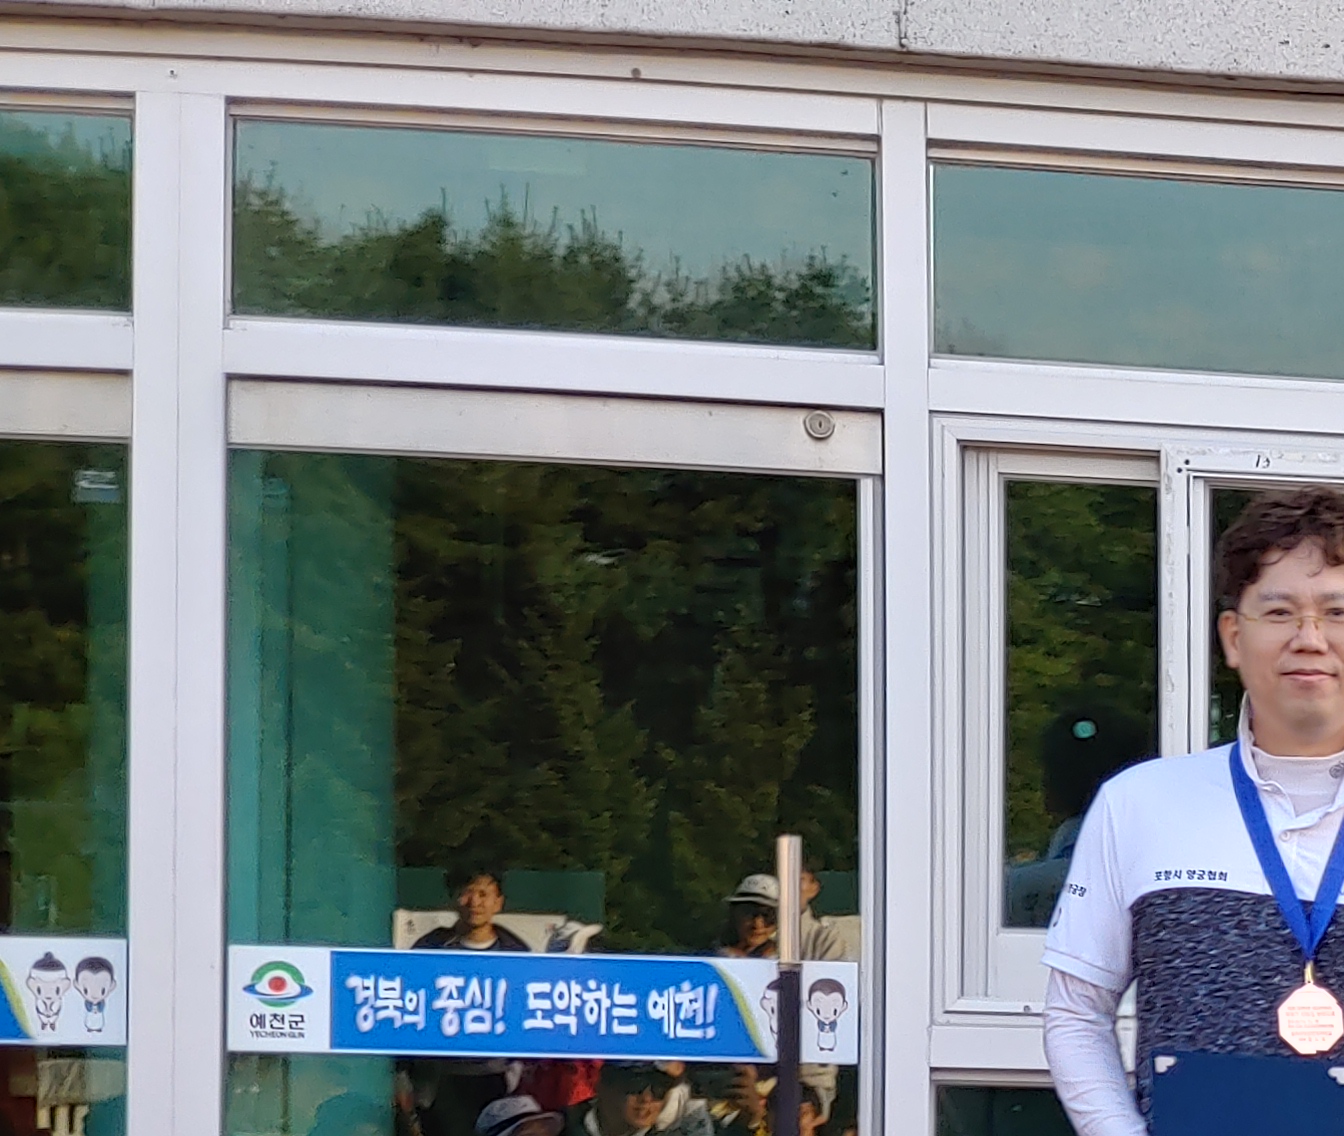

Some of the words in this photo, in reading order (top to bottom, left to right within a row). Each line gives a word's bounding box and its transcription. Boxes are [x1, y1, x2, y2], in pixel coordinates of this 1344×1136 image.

[249, 1012, 305, 1031] 예천군
[345, 974, 427, 1034] 경북의
[431, 974, 507, 1037] 중심!
[522, 979, 638, 1036] 도약하는
[647, 980, 719, 1040] 예천!
